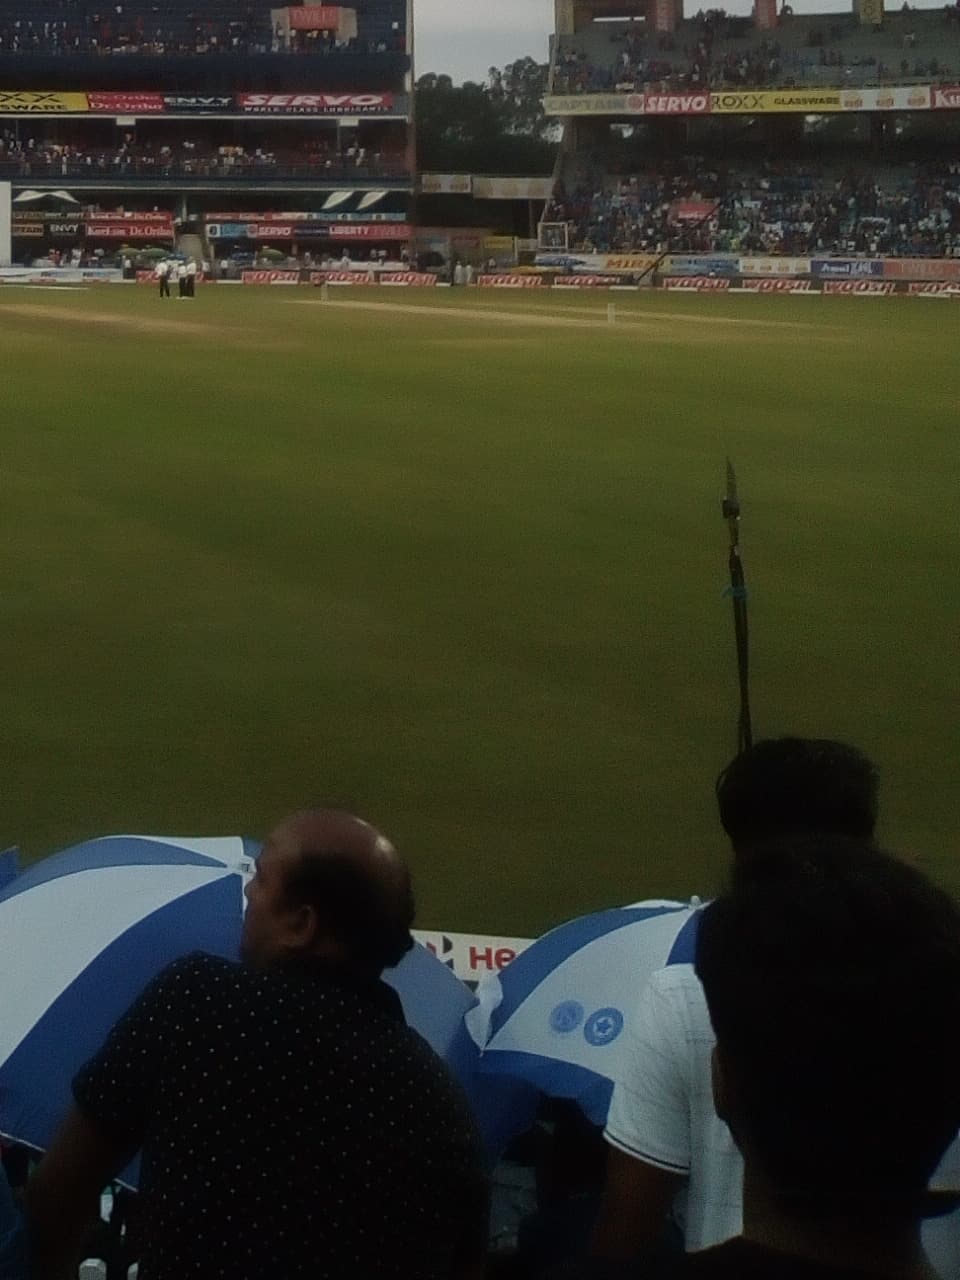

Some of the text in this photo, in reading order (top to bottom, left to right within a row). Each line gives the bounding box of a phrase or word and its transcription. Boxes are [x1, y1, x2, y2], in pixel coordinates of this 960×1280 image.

[240, 95, 383, 107] SERVO
[646, 96, 707, 112] SERVO
[50, 223, 79, 233] ENVY
[469, 946, 516, 971] He
